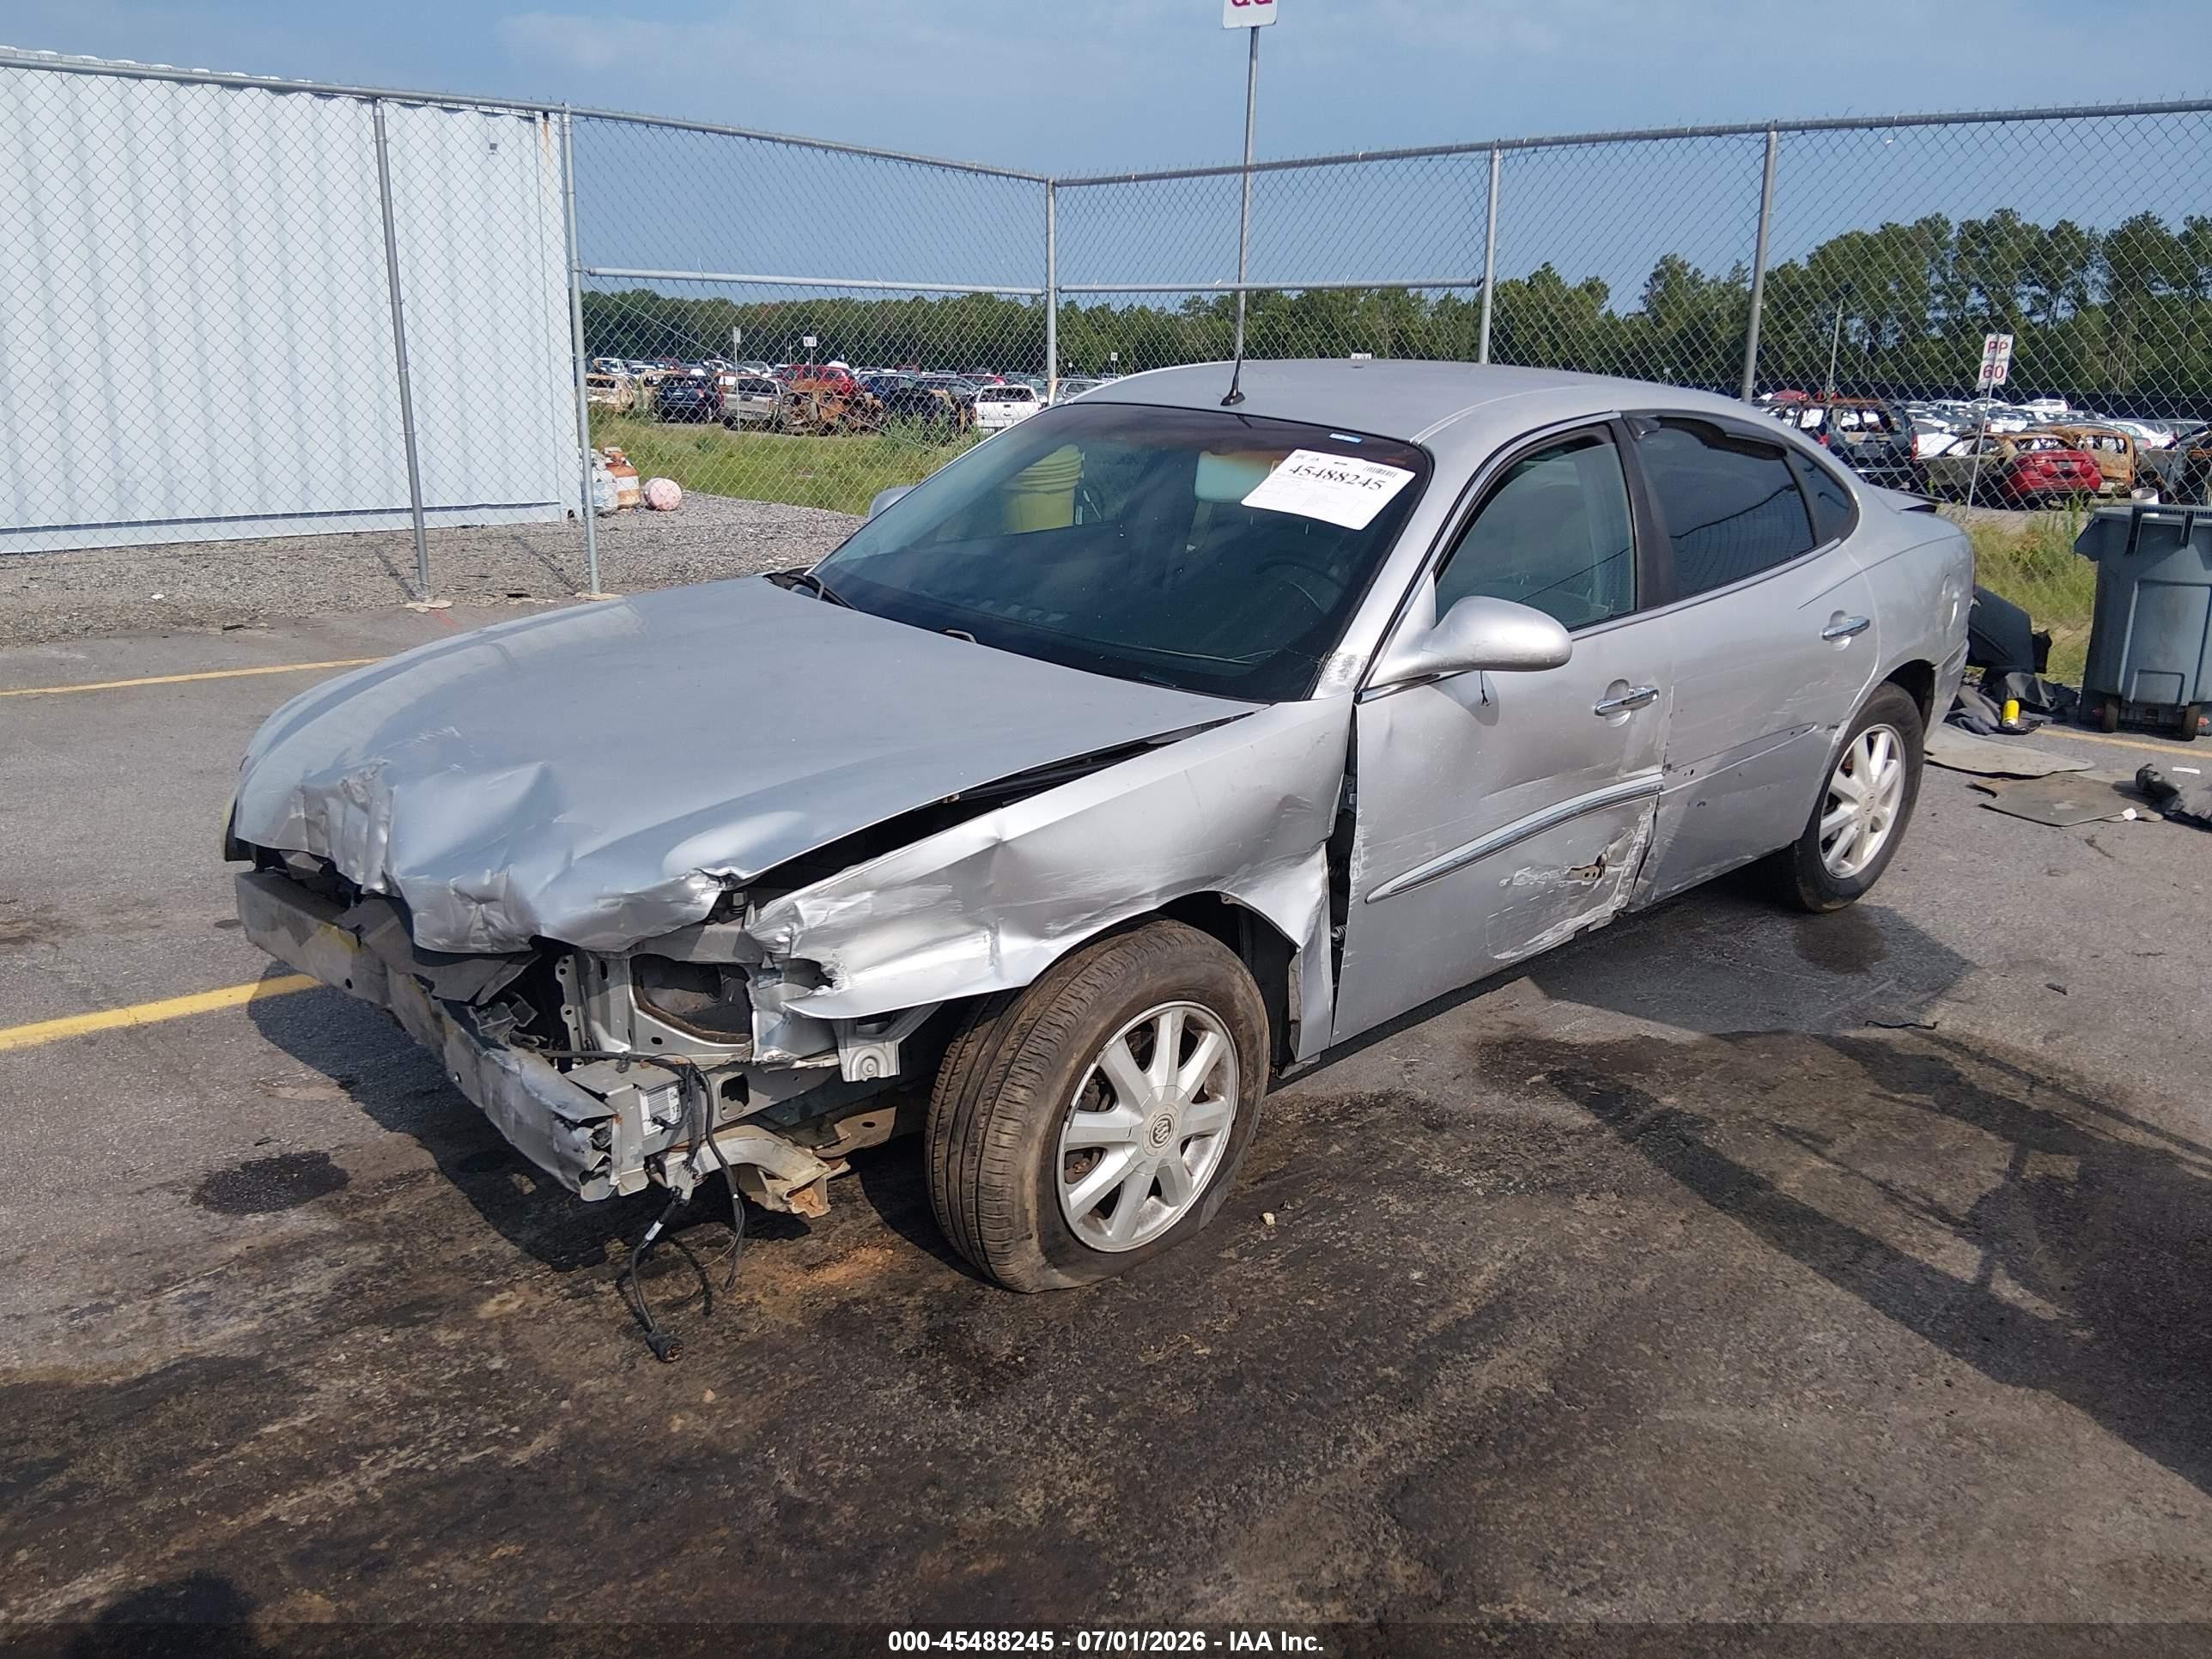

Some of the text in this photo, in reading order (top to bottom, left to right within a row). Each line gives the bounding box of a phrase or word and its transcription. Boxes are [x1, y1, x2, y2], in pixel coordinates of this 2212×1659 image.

[1987, 341, 2008, 354] PP
[1983, 364, 2004, 379] 60
[1289, 465, 1387, 491] 45488245
